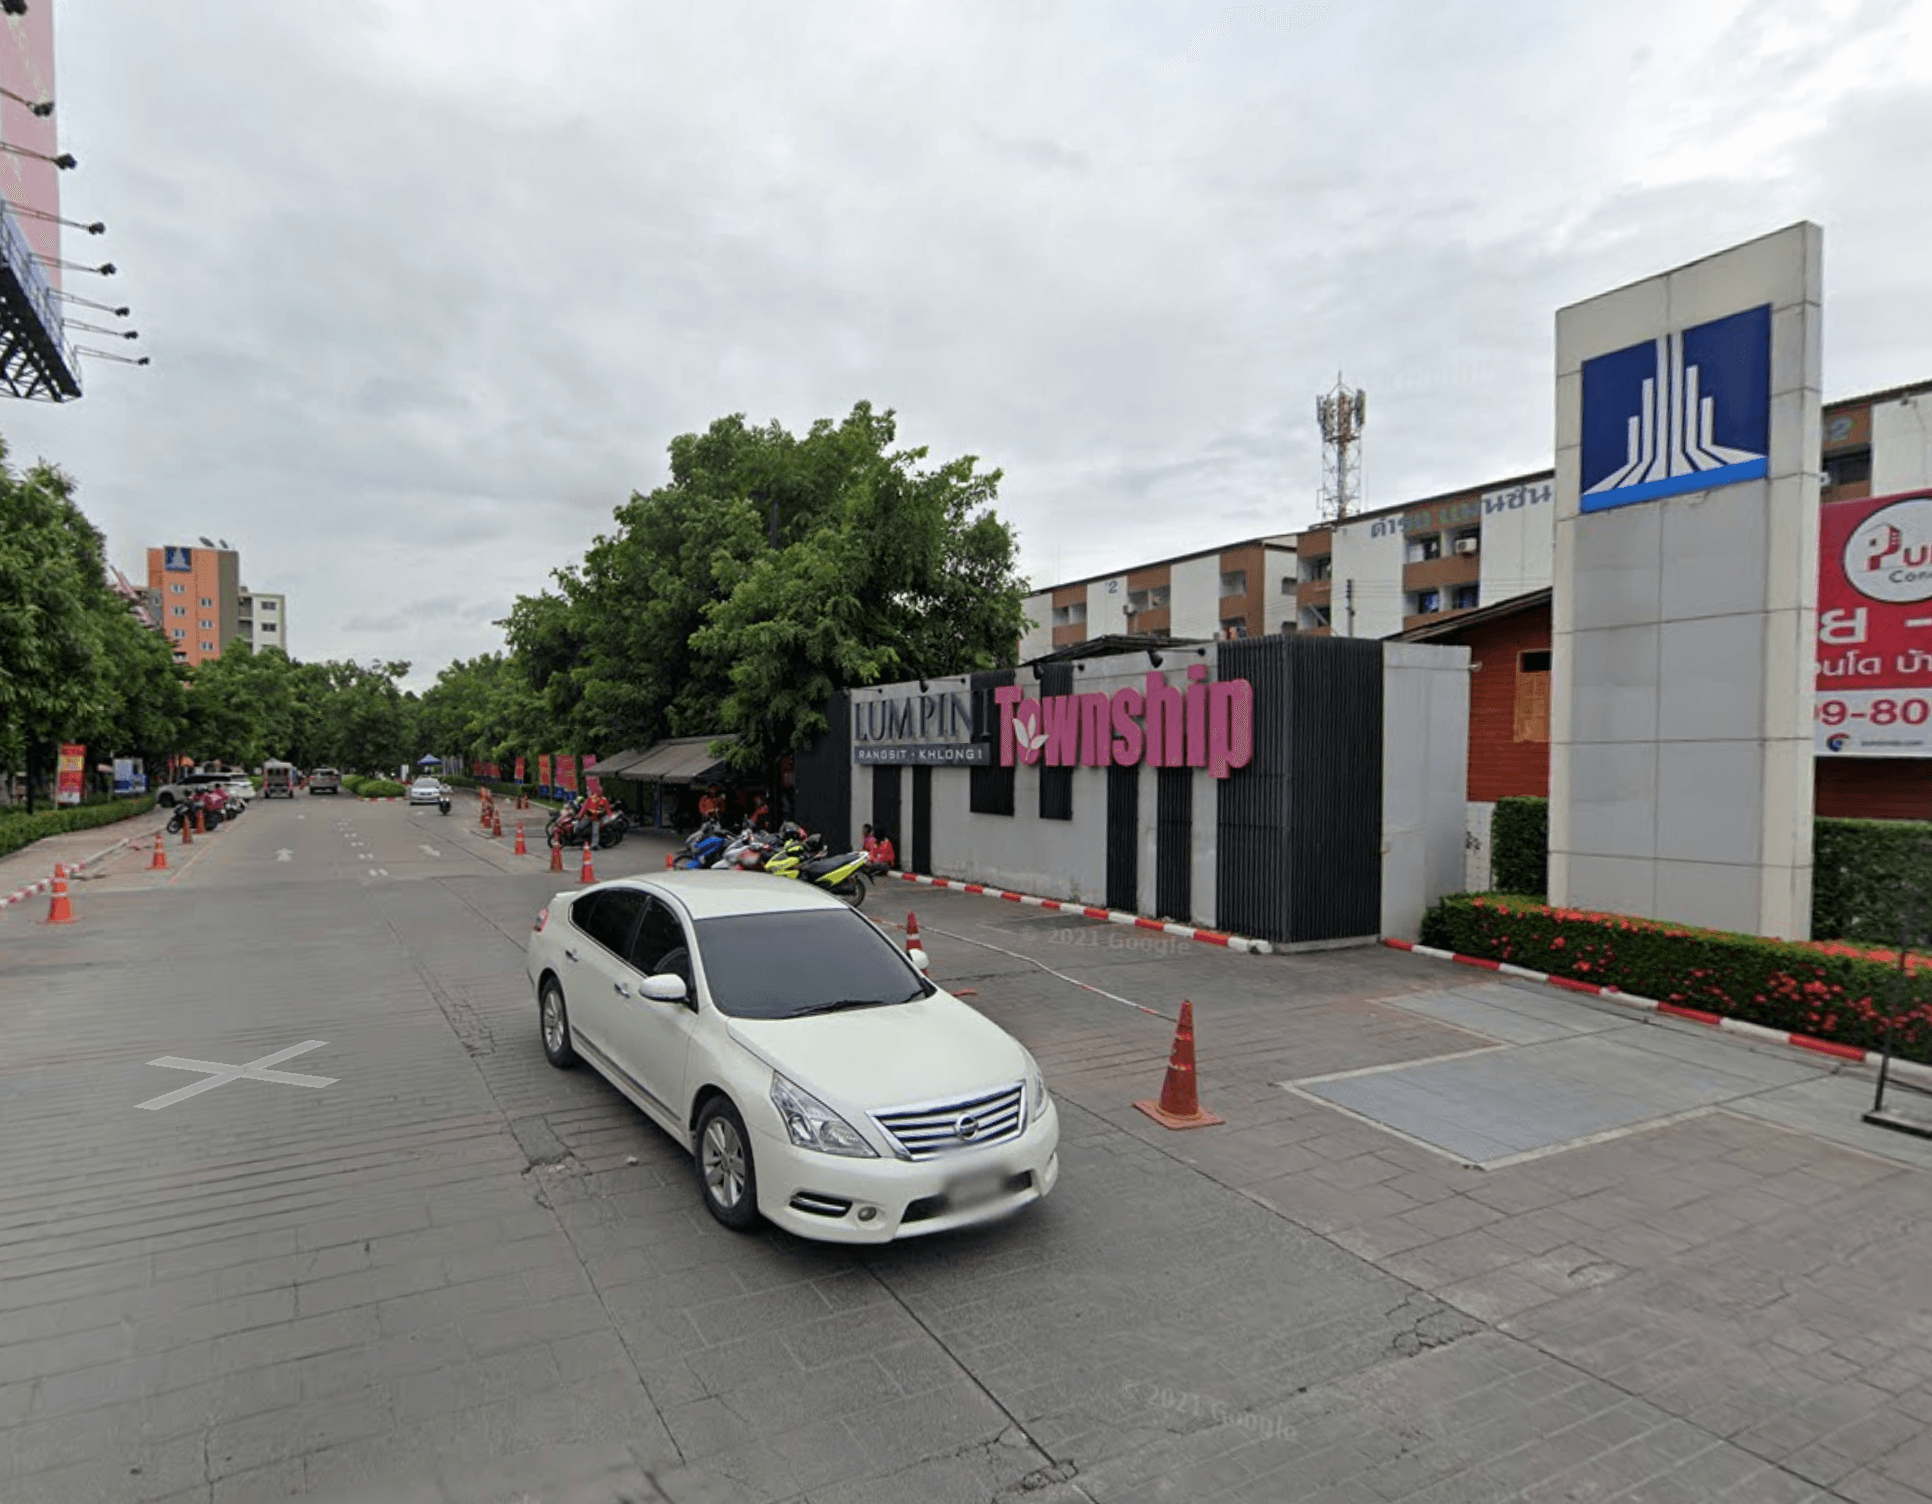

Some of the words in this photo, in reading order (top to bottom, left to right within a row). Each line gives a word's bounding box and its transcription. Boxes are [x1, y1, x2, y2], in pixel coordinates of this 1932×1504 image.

[1866, 525, 1932, 570] Pu
[855, 691, 991, 740] LUMPINI
[995, 664, 1253, 778] Township
